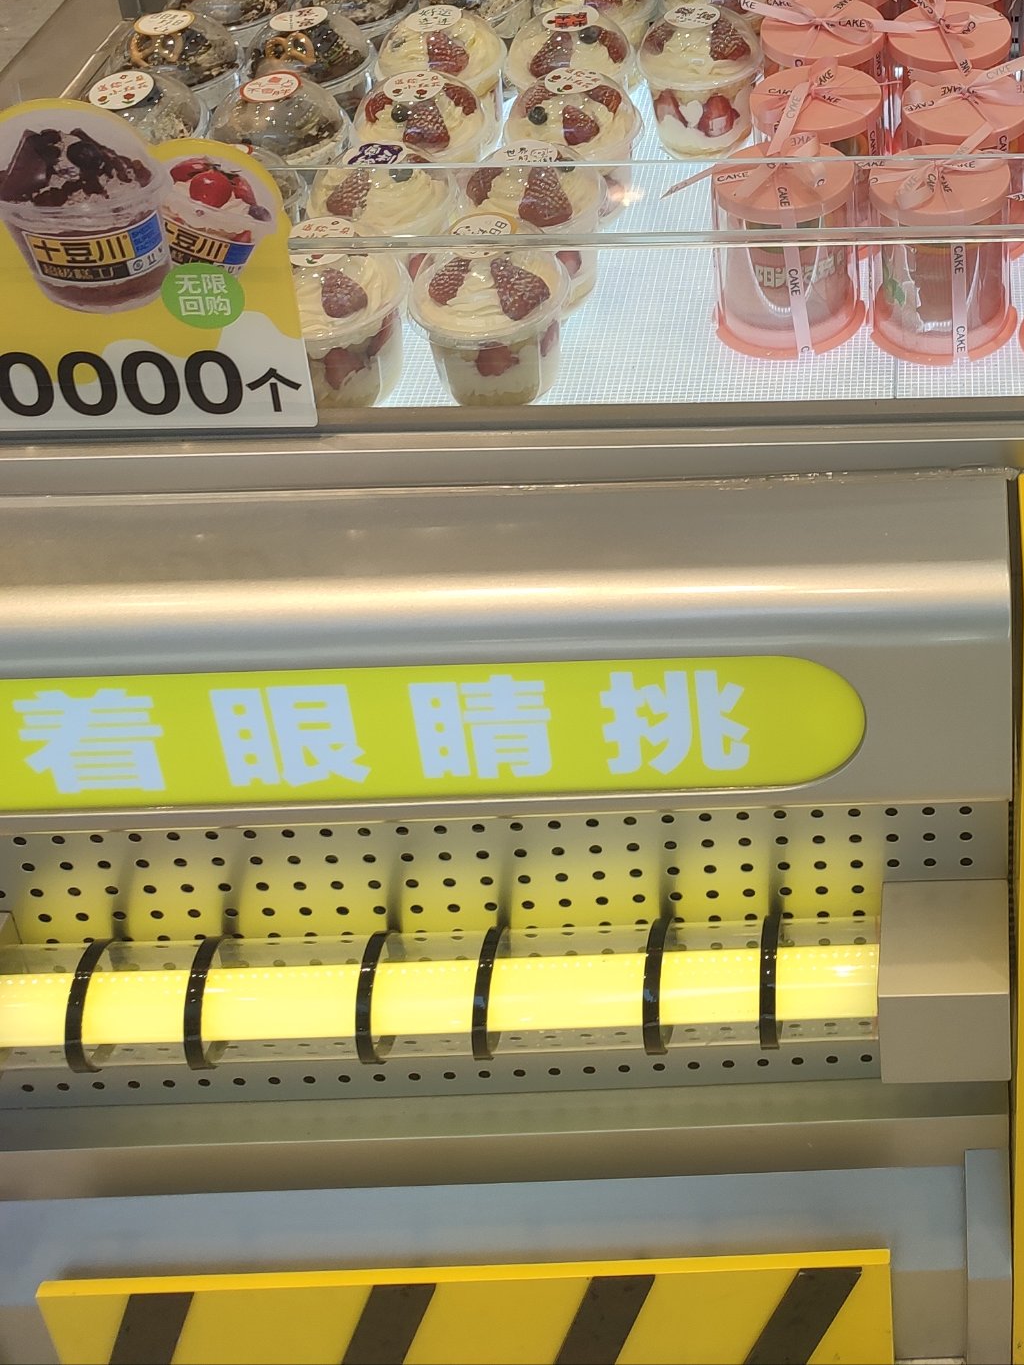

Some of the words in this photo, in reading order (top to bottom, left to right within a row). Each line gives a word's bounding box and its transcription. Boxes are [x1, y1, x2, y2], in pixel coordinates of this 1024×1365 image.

[838, 19, 867, 29] CAKE
[905, 99, 935, 112] CAKE
[716, 171, 751, 183] CAKE
[776, 185, 791, 208] CAKE
[34, 236, 127, 265] 十豆川
[953, 245, 966, 275] CAKE
[175, 273, 229, 294] 无限
[787, 267, 801, 297] CAKE
[178, 296, 232, 317] 回购
[955, 325, 967, 354] CAKE
[12, 669, 750, 794] 着眼睛挑
